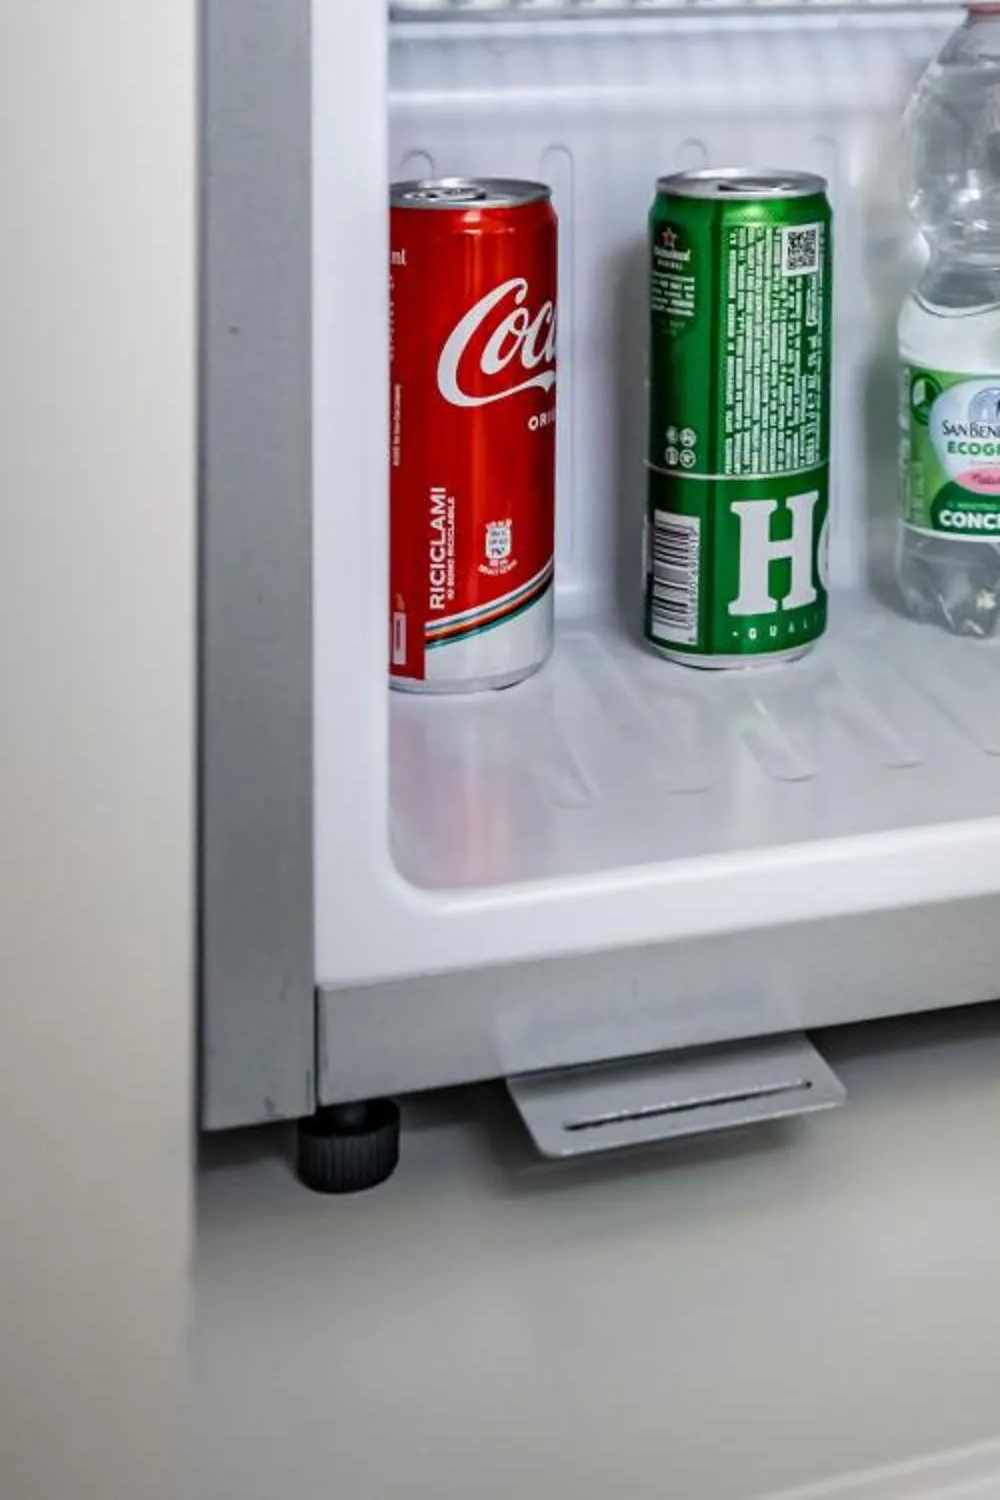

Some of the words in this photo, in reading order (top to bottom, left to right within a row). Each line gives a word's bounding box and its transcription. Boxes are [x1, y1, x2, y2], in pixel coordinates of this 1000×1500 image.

[942, 420, 967, 437] SAN
[429, 487, 446, 609] RICICLAMI
[727, 490, 828, 616] H
